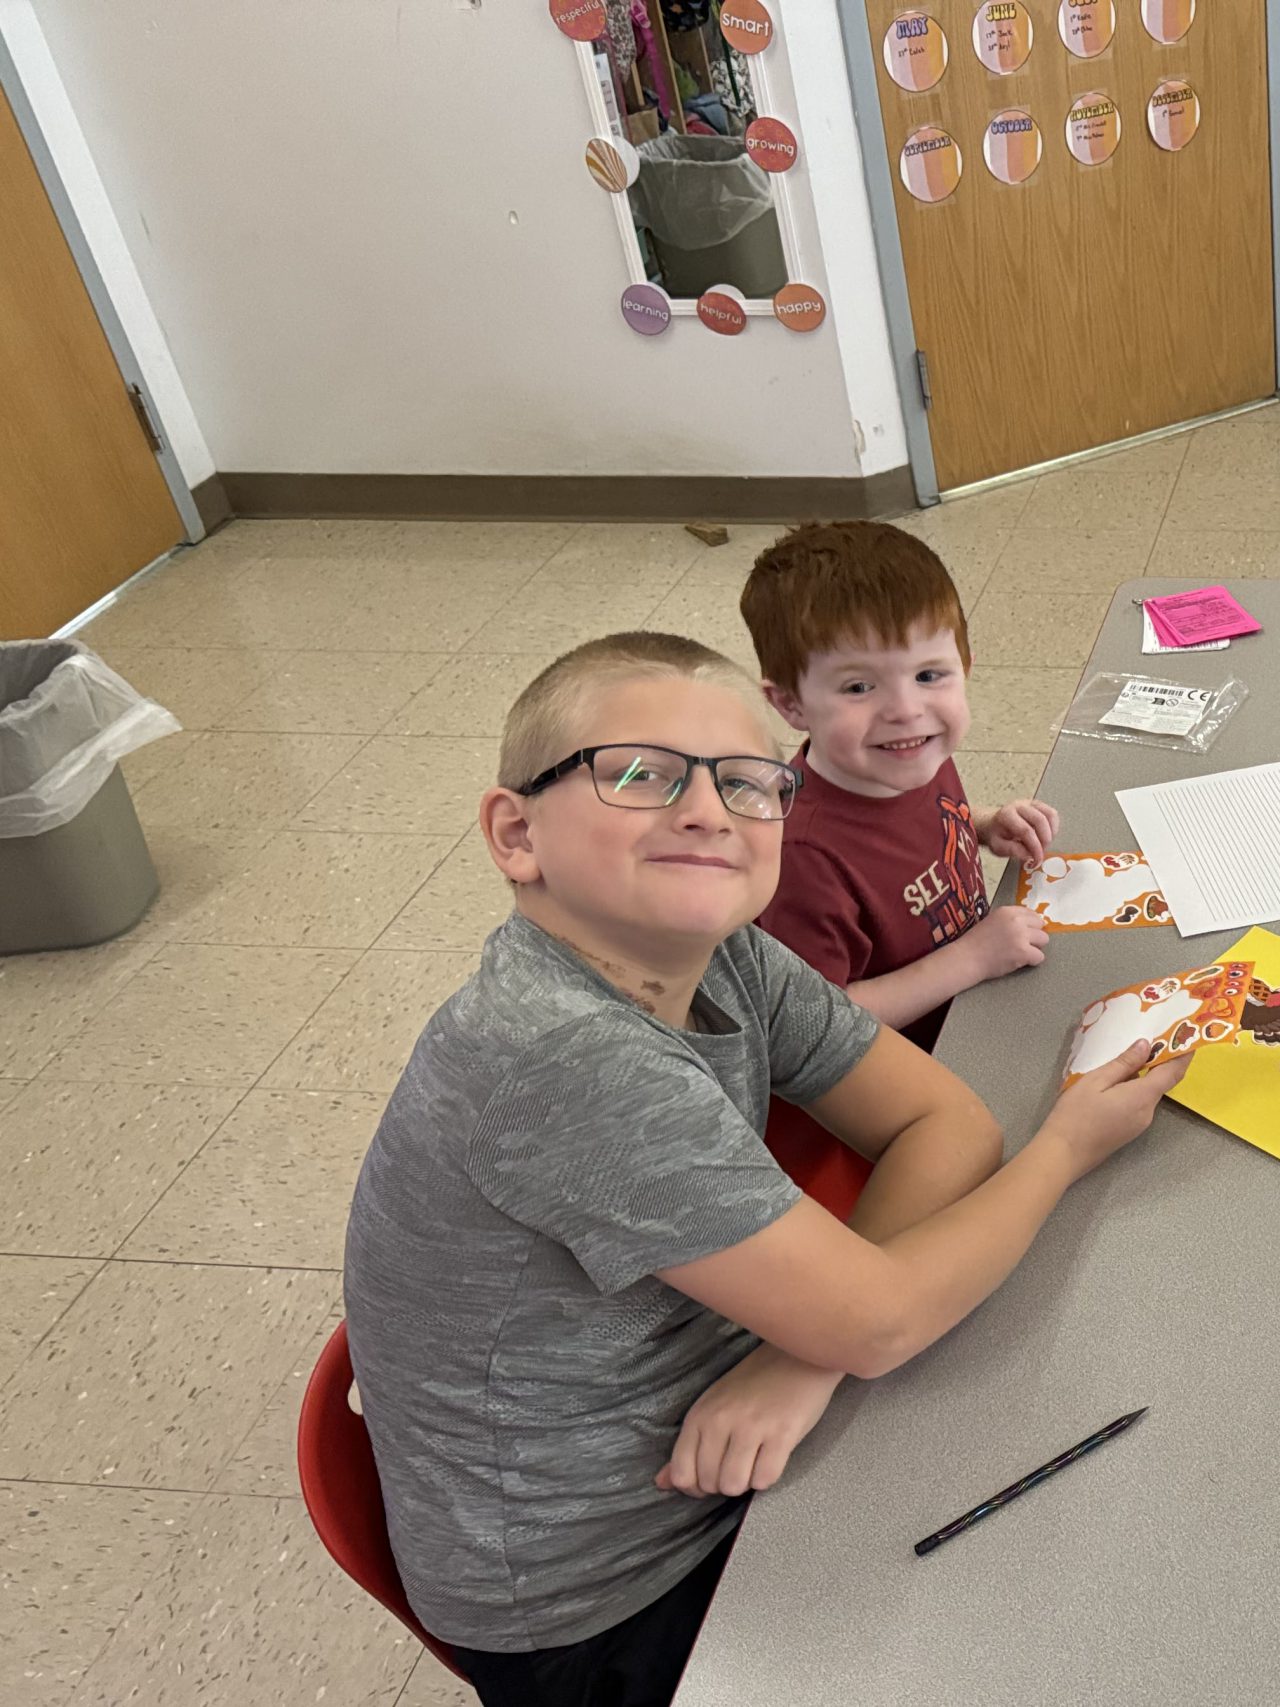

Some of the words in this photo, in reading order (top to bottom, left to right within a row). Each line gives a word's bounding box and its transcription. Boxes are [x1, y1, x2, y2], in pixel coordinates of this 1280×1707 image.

[985, 3, 1017, 22] JUNE
[722, 12, 770, 38] smart
[896, 16, 928, 40] MAY
[1070, 102, 1115, 122] NOVEMBER
[991, 118, 1033, 135] OCTOBER
[746, 135, 795, 155] growing
[904, 136, 952, 157] SEPTEMBER
[623, 299, 669, 322] learning
[700, 304, 743, 326] helpful
[776, 298, 821, 314] happy
[903, 859, 950, 917] SEE
